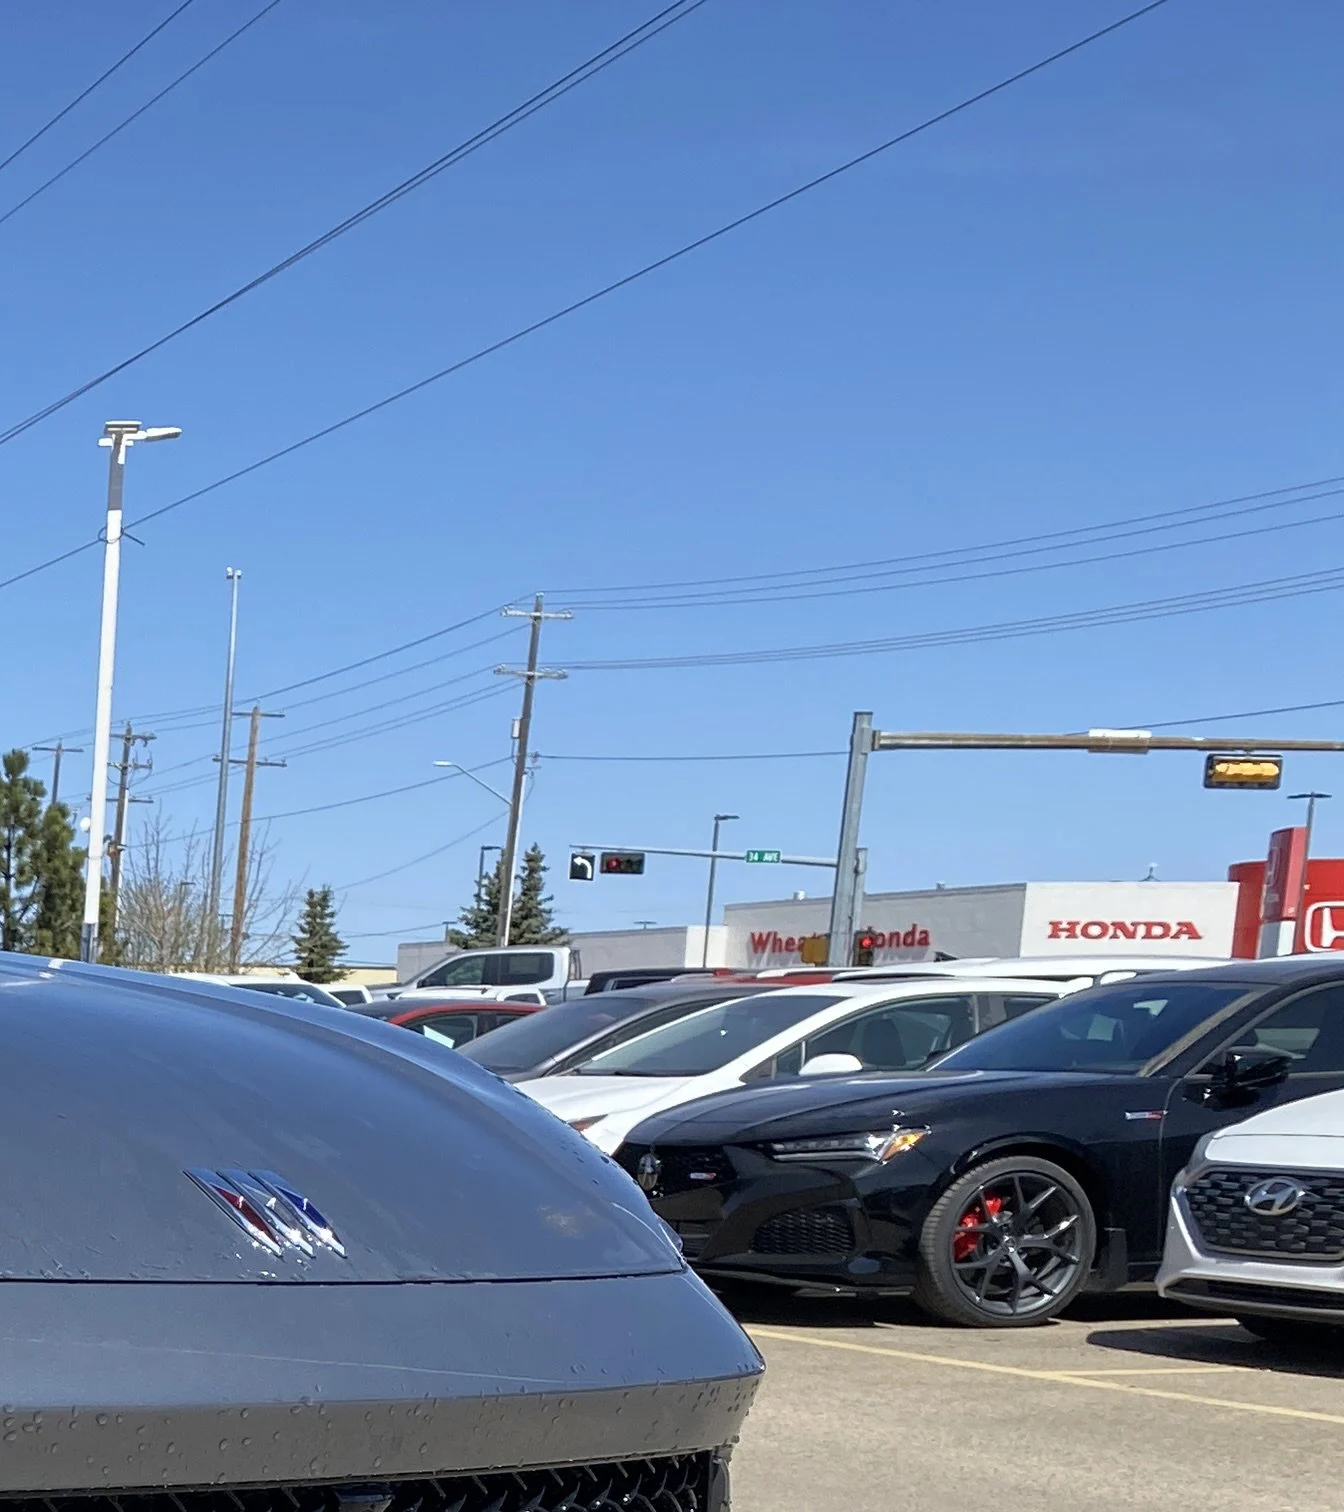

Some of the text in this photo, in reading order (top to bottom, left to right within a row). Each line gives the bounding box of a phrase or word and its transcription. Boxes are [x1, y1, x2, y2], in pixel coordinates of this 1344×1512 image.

[763, 852, 779, 861] AVE
[867, 923, 930, 949] onda
[1047, 920, 1203, 940] HONDA
